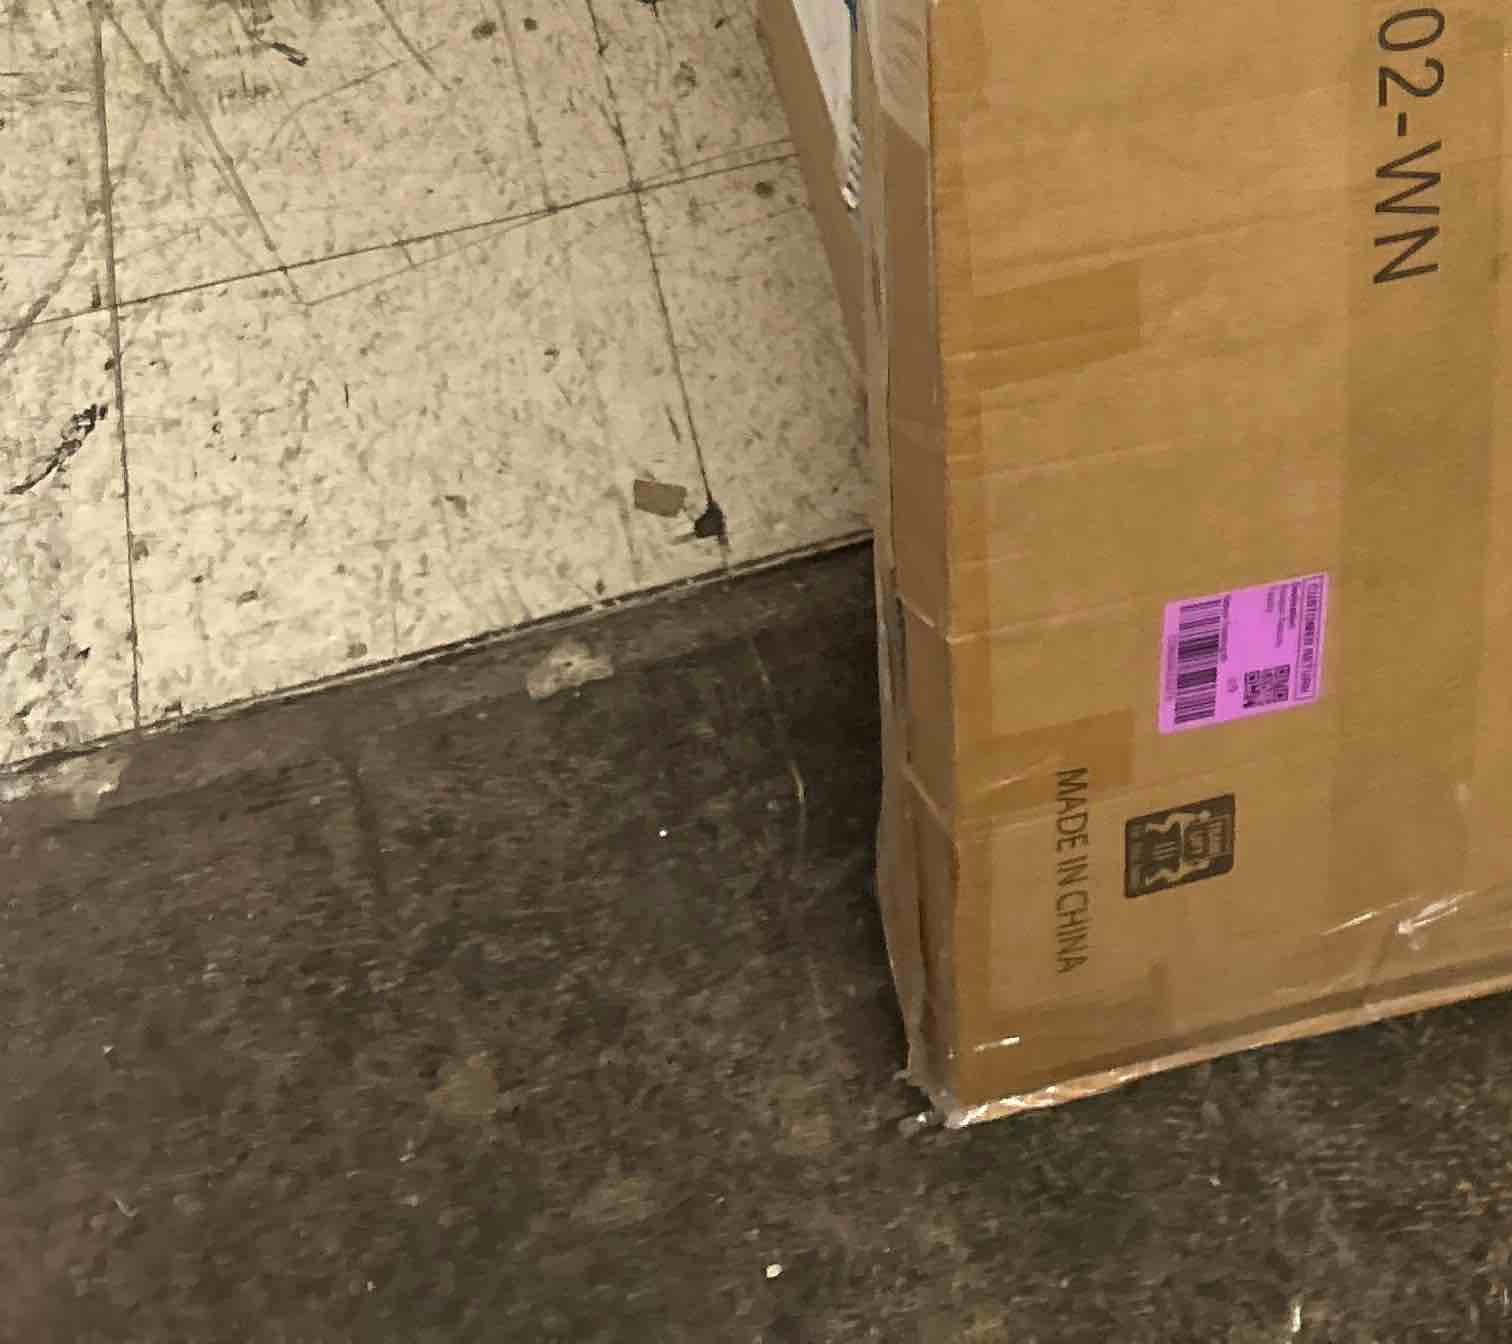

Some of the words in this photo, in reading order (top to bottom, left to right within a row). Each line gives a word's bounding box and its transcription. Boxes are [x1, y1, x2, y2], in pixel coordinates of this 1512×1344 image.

[1056, 767, 1089, 853] MADE
[1056, 855, 1089, 888] IN
[1056, 890, 1089, 976] CHINA
